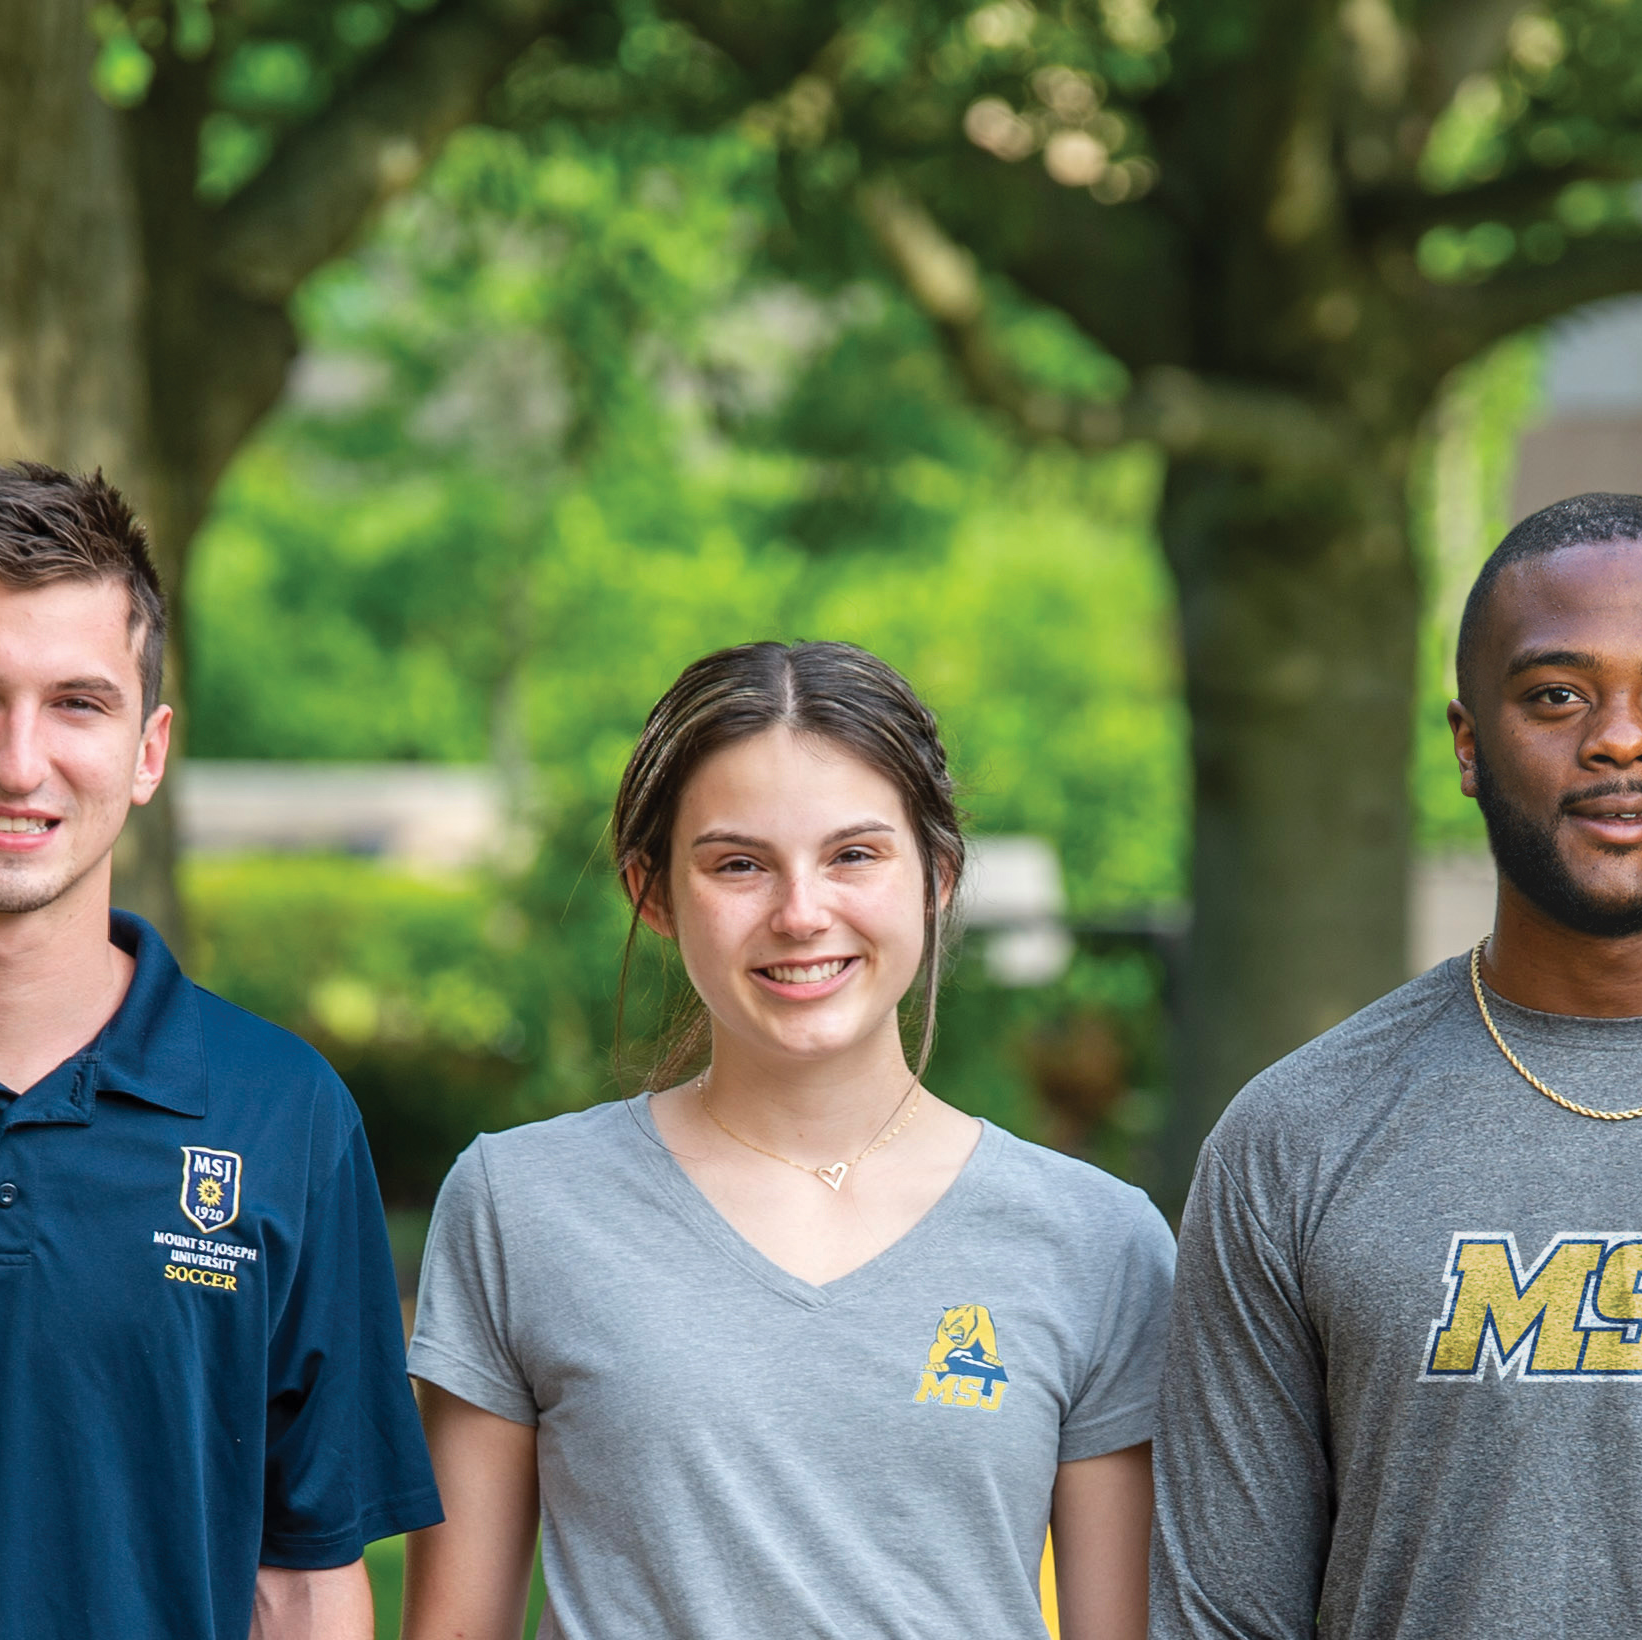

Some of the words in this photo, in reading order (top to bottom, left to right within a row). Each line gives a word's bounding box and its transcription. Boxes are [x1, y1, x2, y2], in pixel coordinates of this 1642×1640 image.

[193, 1154, 232, 1184] MSJ
[194, 1205, 225, 1222] 1920
[153, 1231, 198, 1250] MOUNT
[212, 1242, 257, 1261] JOSEPH
[170, 1249, 238, 1272] UNIVERSITY
[164, 1264, 237, 1291] SOCCER
[912, 1370, 1007, 1411] MSJ
